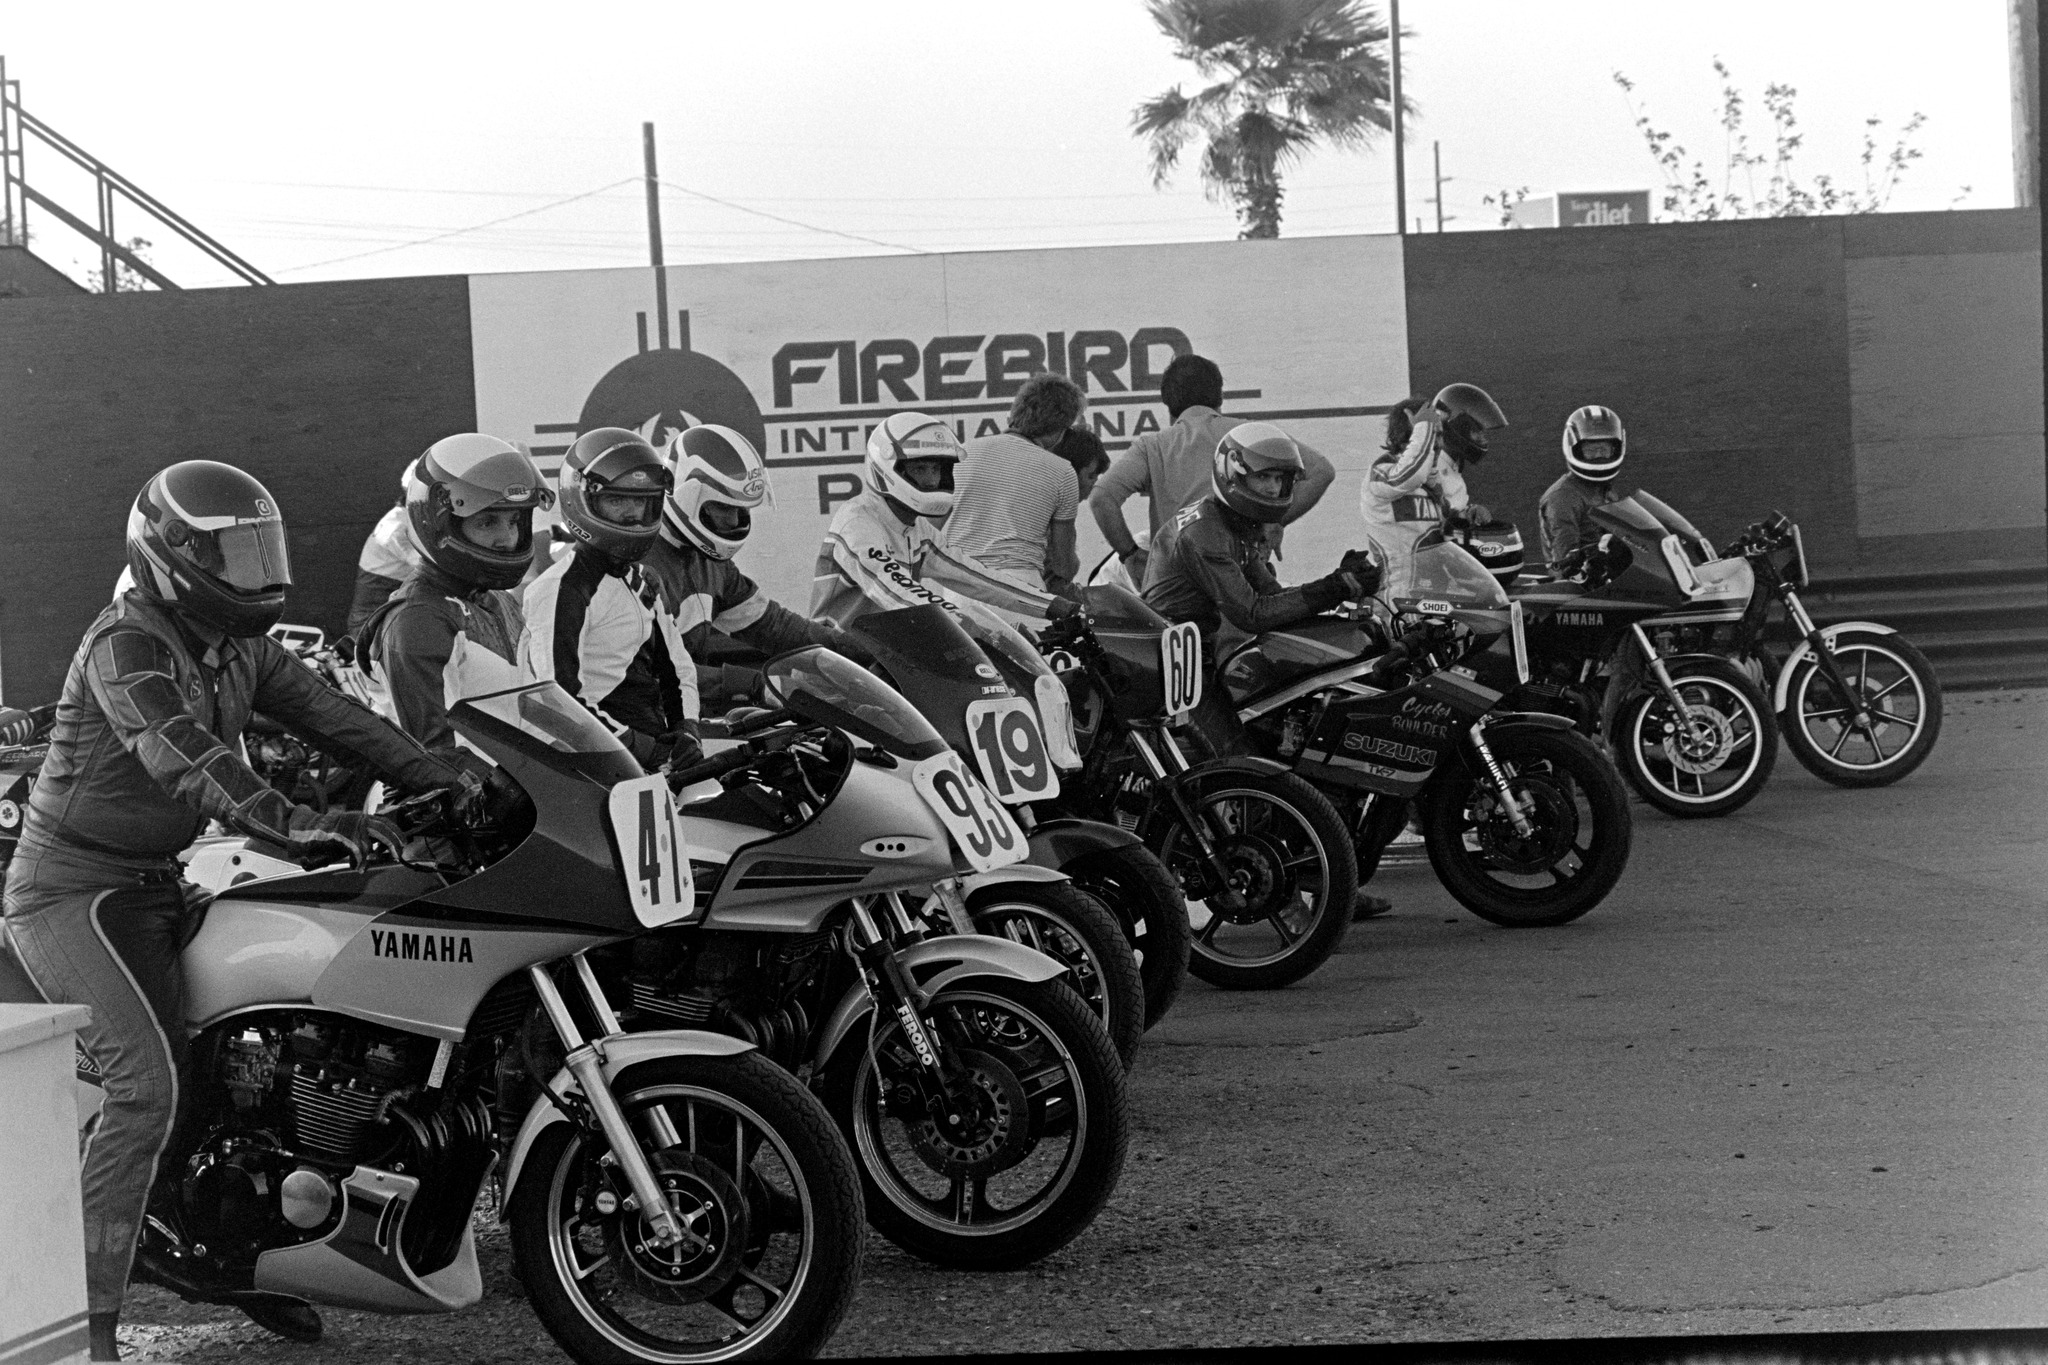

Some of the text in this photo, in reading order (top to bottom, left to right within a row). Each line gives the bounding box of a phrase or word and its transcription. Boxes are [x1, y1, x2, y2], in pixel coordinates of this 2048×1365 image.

[772, 327, 1193, 408] FIREBIRD
[1422, 602, 1448, 612] SHOEI
[1556, 612, 1604, 626] YAMAHA
[1169, 626, 1196, 711] 60
[976, 710, 1048, 797] 19
[1343, 732, 1438, 767] SUZUKI
[932, 763, 1014, 858] 93
[638, 789, 682, 906] 41
[371, 929, 474, 963] YAMAHA
[897, 1004, 933, 1066] FERODO
